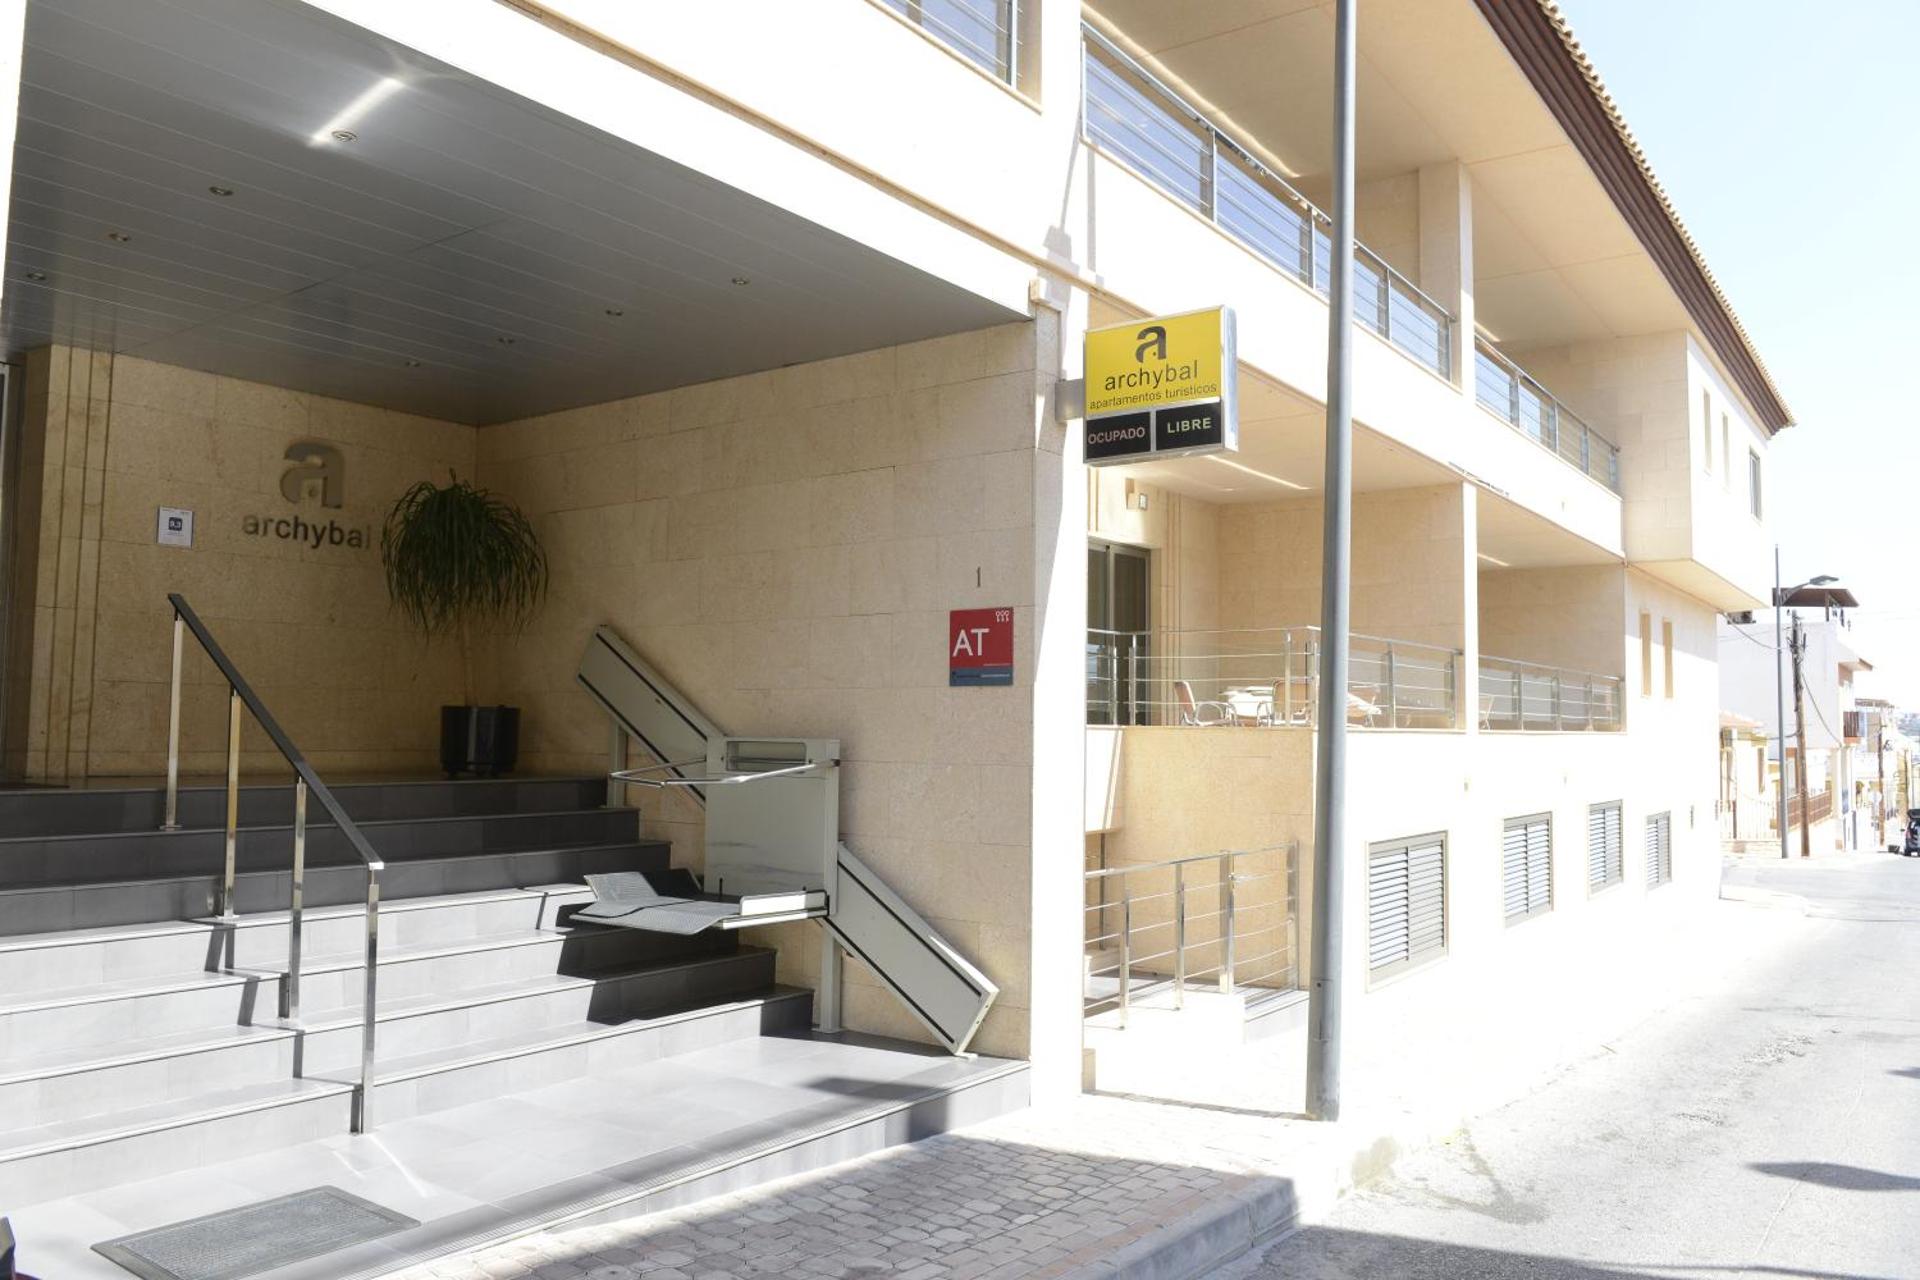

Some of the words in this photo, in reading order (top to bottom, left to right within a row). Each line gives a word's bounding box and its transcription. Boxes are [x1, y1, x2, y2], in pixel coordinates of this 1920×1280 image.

[1136, 325, 1167, 363] a
[1105, 360, 1198, 390] archybal
[1090, 392, 1162, 409] apartamentos
[1088, 427, 1146, 444] OCUPADO
[1167, 417, 1212, 433] LIBRE
[242, 515, 370, 549] archybal
[952, 628, 990, 657] AT
